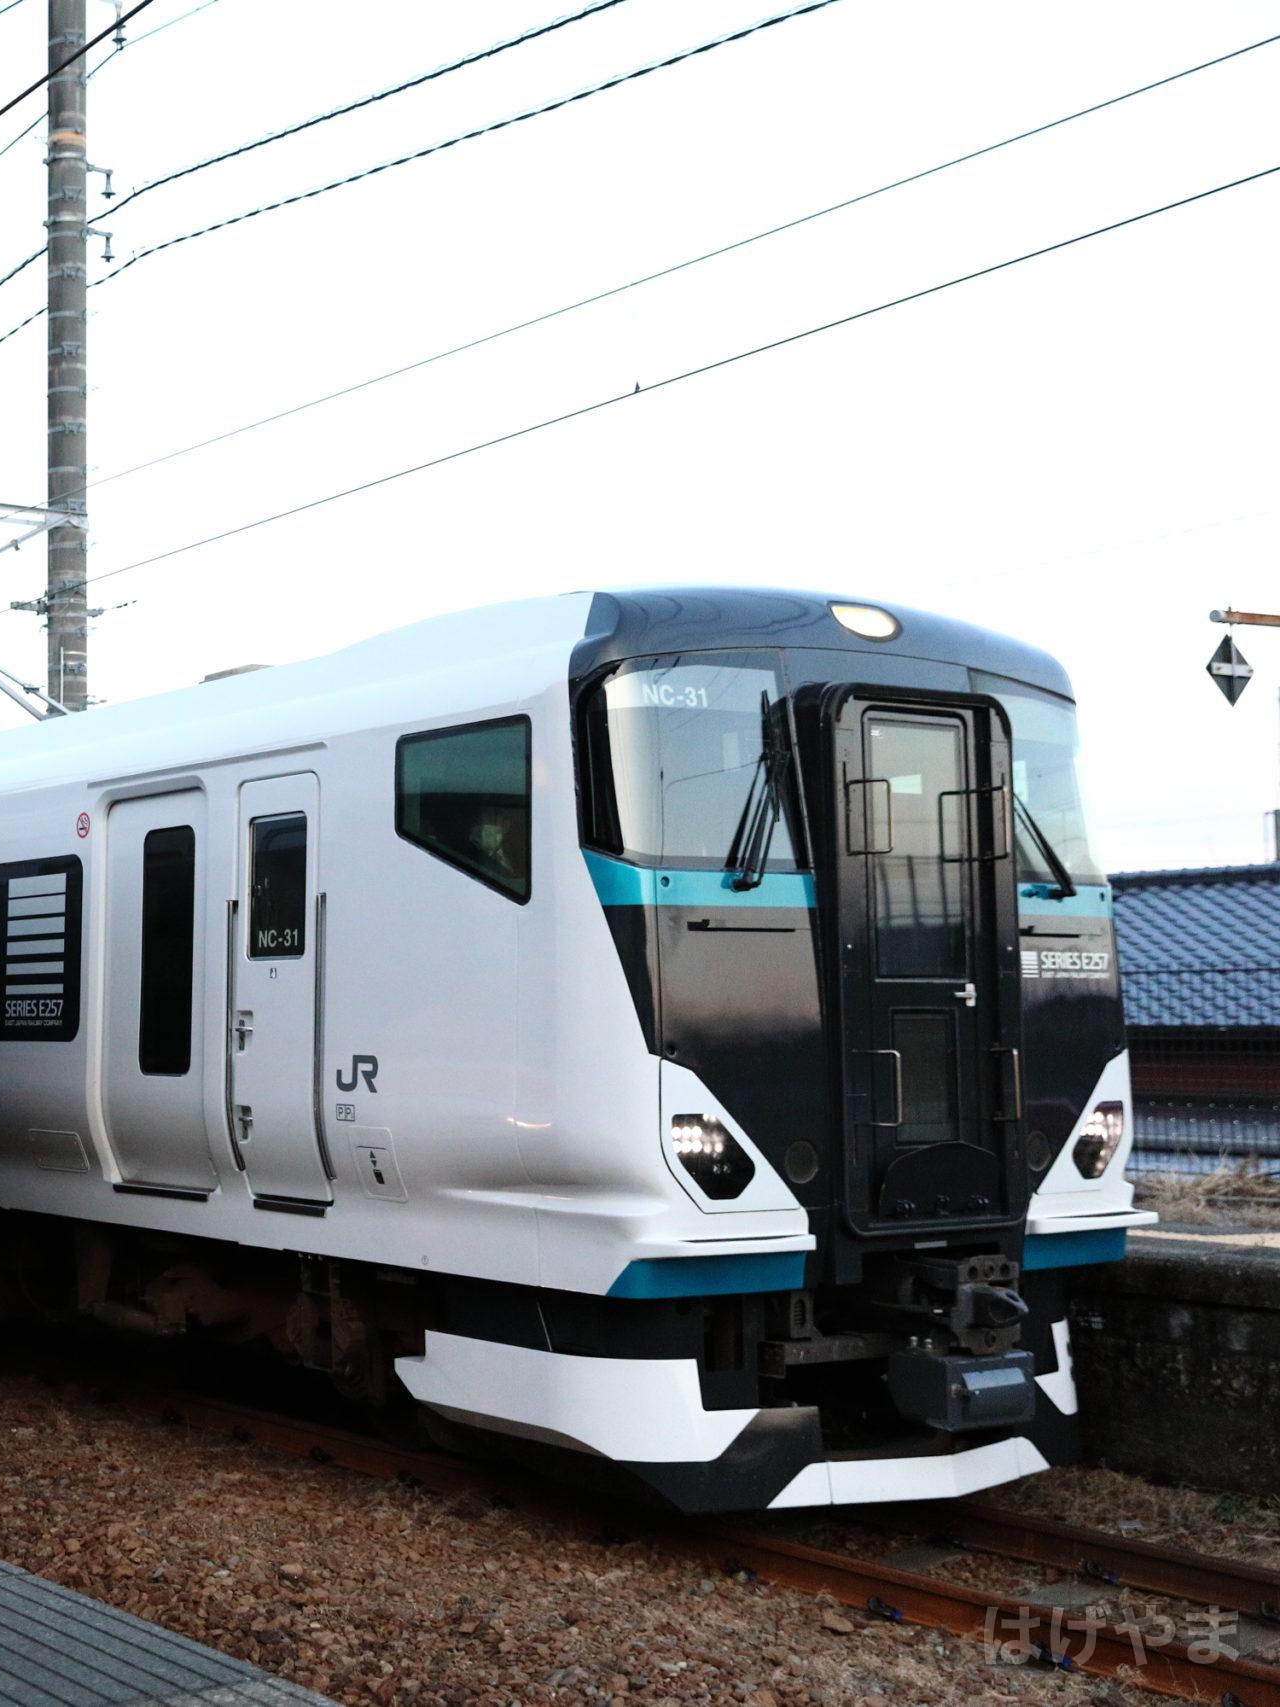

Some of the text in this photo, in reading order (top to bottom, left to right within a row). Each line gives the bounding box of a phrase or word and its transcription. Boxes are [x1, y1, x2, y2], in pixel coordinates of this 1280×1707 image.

[642, 683, 708, 707] NC-31
[258, 928, 298, 948] NC-31
[1041, 951, 1081, 970] SERIES
[5, 999, 64, 1017] SERIES E257
[336, 1054, 379, 1093] JR
